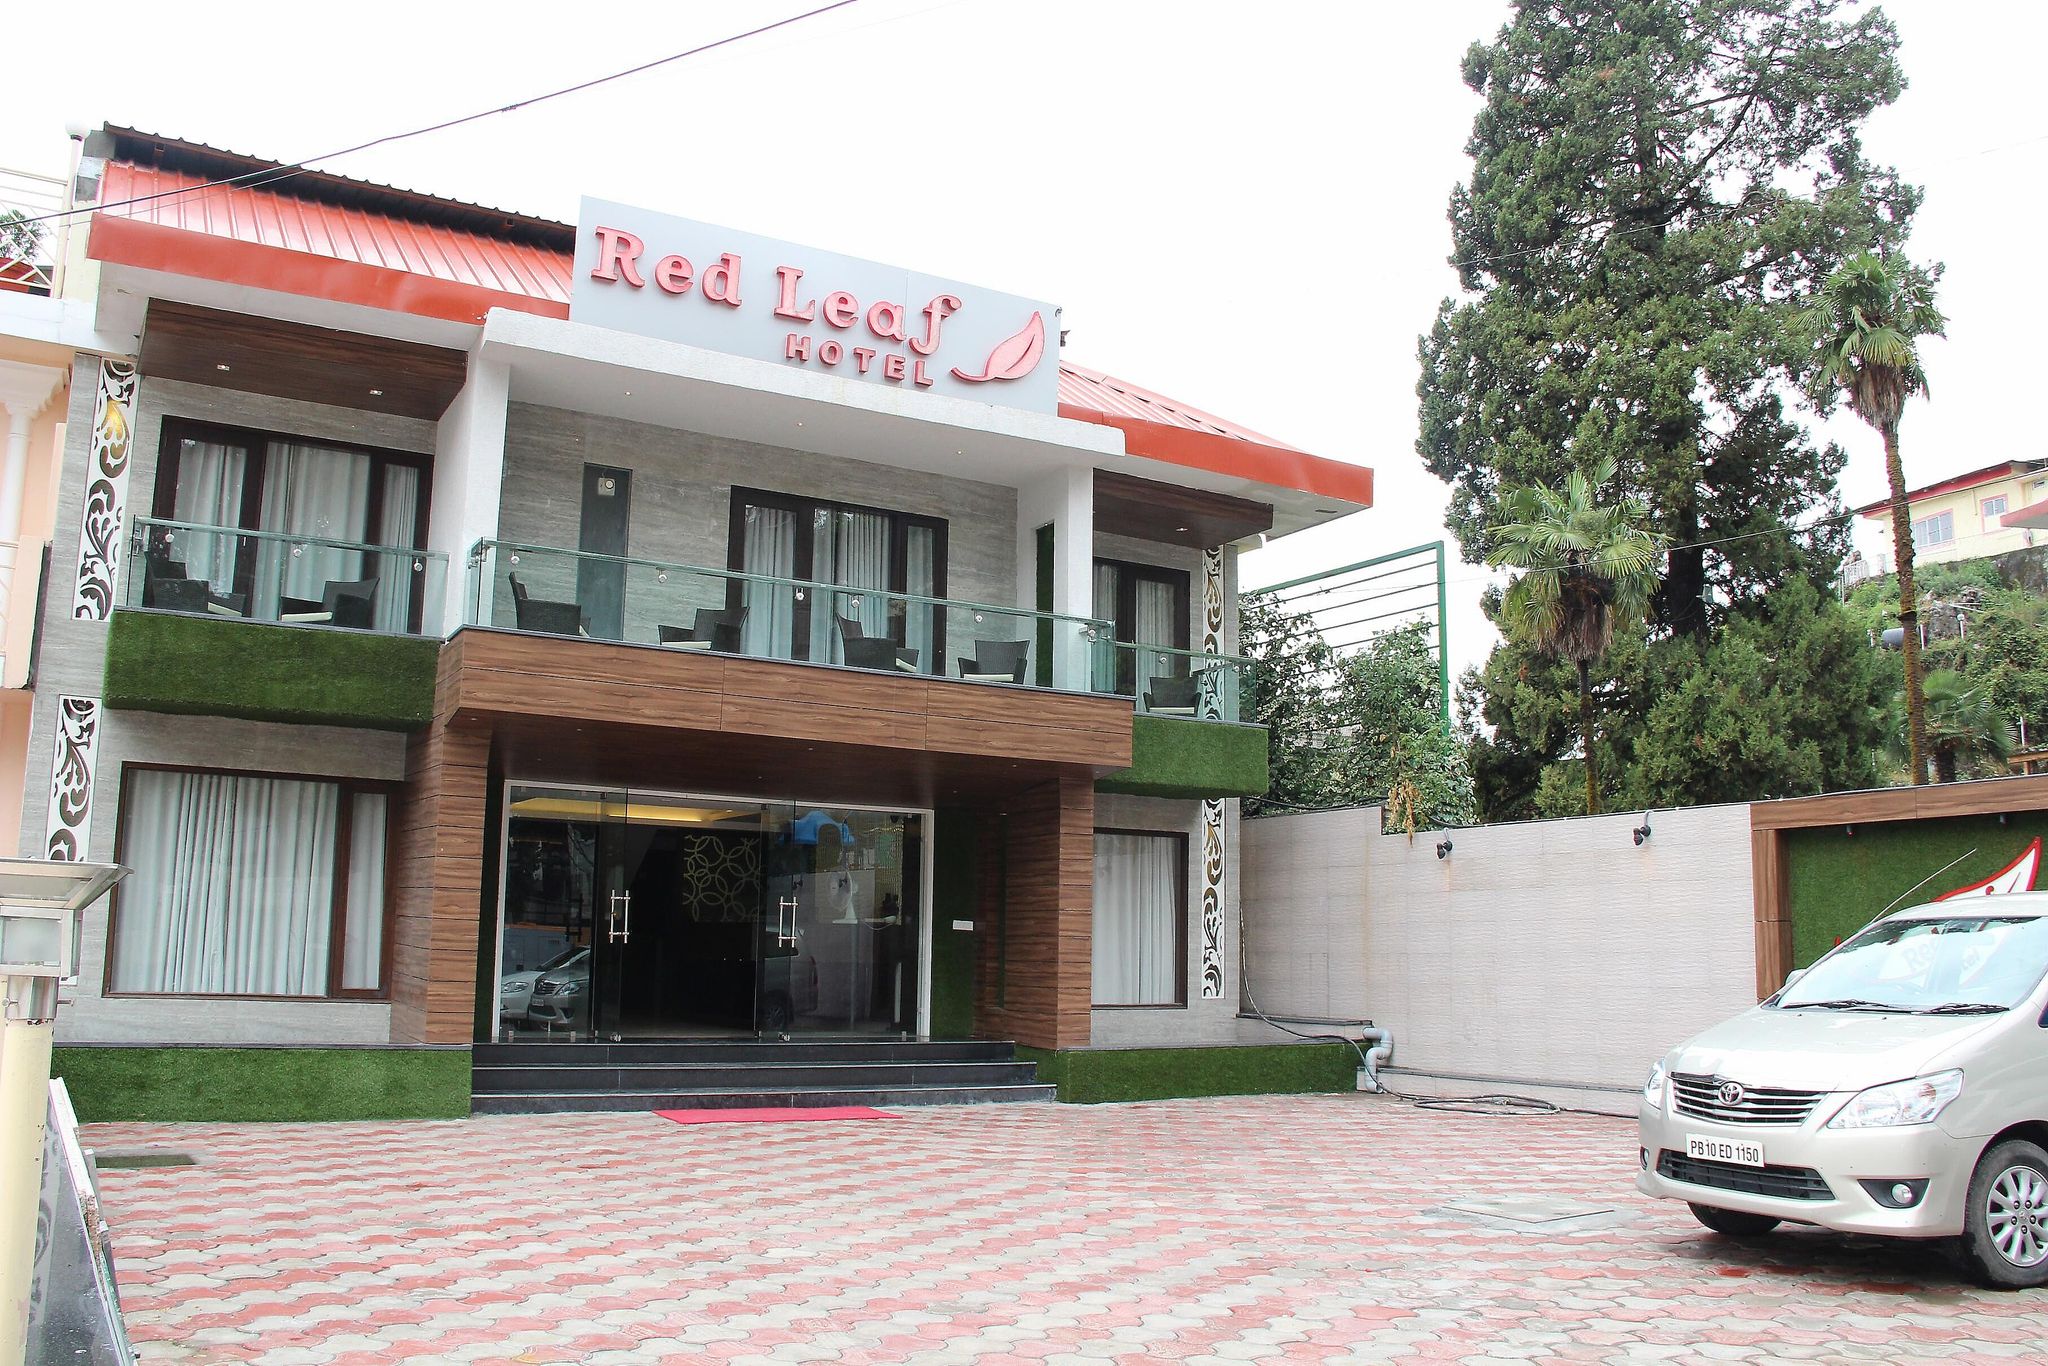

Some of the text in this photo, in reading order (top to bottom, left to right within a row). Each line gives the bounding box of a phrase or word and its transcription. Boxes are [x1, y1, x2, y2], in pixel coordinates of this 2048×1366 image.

[590, 225, 963, 356] Red Leaf
[784, 332, 934, 387] HOTEL
[1690, 1140, 1759, 1163] PB10 ED 1150
